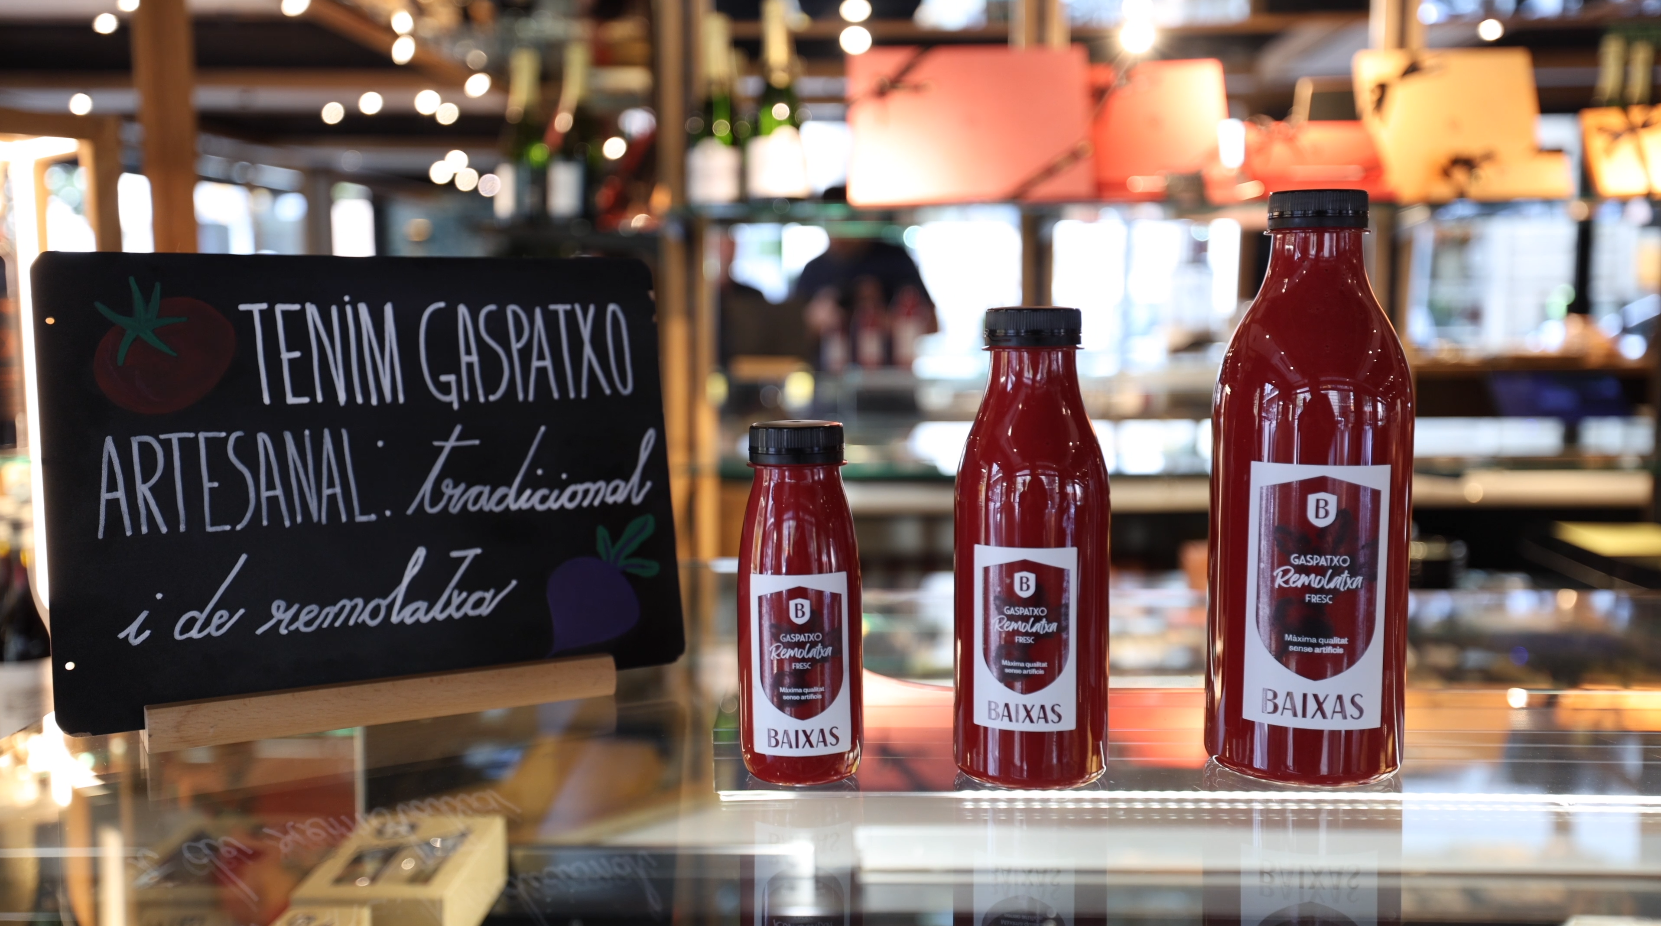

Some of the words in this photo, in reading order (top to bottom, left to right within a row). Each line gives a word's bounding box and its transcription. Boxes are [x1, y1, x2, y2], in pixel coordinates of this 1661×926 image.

[420, 301, 633, 410] GASPATXO
[98, 428, 392, 539] ARTESANAL:
[407, 424, 656, 515] tradicional
[1315, 498, 1329, 519] B
[1290, 554, 1350, 566] GASPATXO
[1019, 577, 1030, 591] B
[1274, 565, 1363, 590] Remolatxa
[118, 592, 164, 646] i
[174, 552, 247, 639] de
[256, 547, 516, 635] remolatxa
[1305, 594, 1333, 604] FRESC
[794, 603, 805, 618] B
[1004, 606, 1047, 616] GASPATXO
[992, 616, 1057, 633] Remolatxa
[780, 633, 822, 643] GASPATXO
[1015, 636, 1035, 644] FRESC
[1319, 637, 1348, 646] qualitat
[770, 643, 832, 661] Remolatxa
[1314, 646, 1344, 654] artificis
[792, 662, 811, 670] FRESC
[803, 686, 825, 694] qualitat
[987, 699, 1062, 724] BAIXAS
[1261, 688, 1365, 720] BAIXAS
[768, 726, 839, 749] BAIXAS
